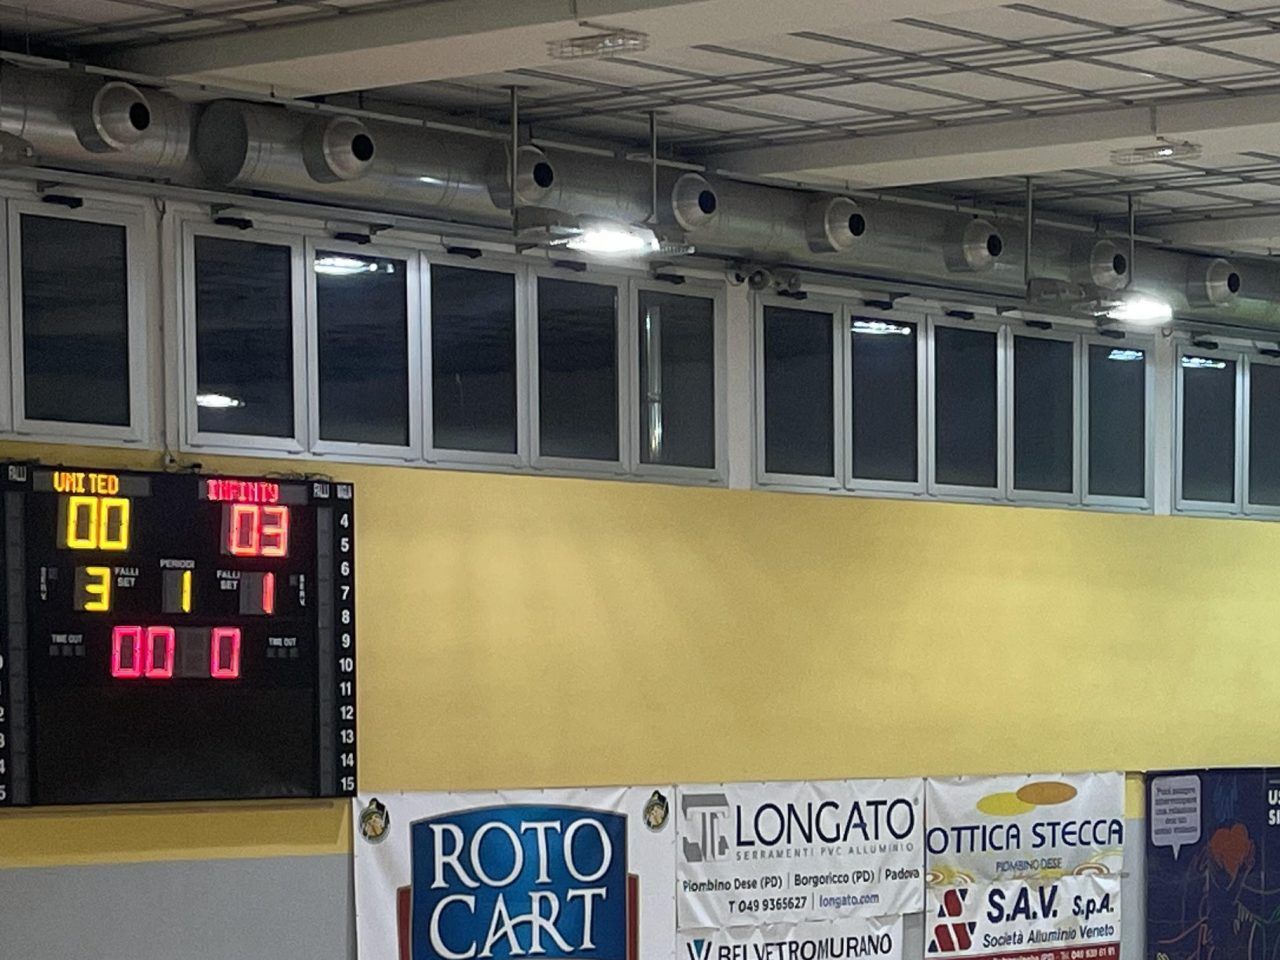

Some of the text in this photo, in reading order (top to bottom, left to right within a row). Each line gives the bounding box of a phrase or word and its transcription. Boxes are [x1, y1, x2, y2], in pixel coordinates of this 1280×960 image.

[67, 495, 130, 550] 00
[339, 513, 349, 528] 4
[229, 504, 290, 558] 03
[339, 537, 349, 552] 5
[340, 562, 350, 575] 6
[84, 566, 111, 611] 3
[182, 570, 192, 613] 1
[262, 571, 275, 615] 1
[341, 586, 350, 600] 7
[341, 610, 351, 623] 8
[341, 634, 351, 647] 9
[111, 625, 241, 679] 00 0
[338, 658, 353, 671] 10
[339, 682, 351, 695] 11
[339, 706, 354, 719] 12
[339, 730, 354, 743] 13
[339, 754, 354, 767] 14
[339, 778, 354, 791] 15
[735, 798, 915, 847] LONGATO
[927, 819, 1124, 854] OTTICA STECCA
[428, 817, 613, 889] ROTO
[735, 842, 914, 861] SERRAMENTI PVC ALLUMINIO
[996, 857, 1063, 873] PIOMBINO DESE
[683, 868, 920, 893] Piombino Dese (PD) Borgoricco (PD) Padova
[738, 899, 760, 912] 049
[762, 896, 807, 911] 9365627
[819, 893, 880, 908] longato.com
[986, 885, 1115, 923] S.A.V. S.p.A.
[429, 887, 607, 960] CART
[982, 924, 1115, 948] Società Alluminio Veneto
